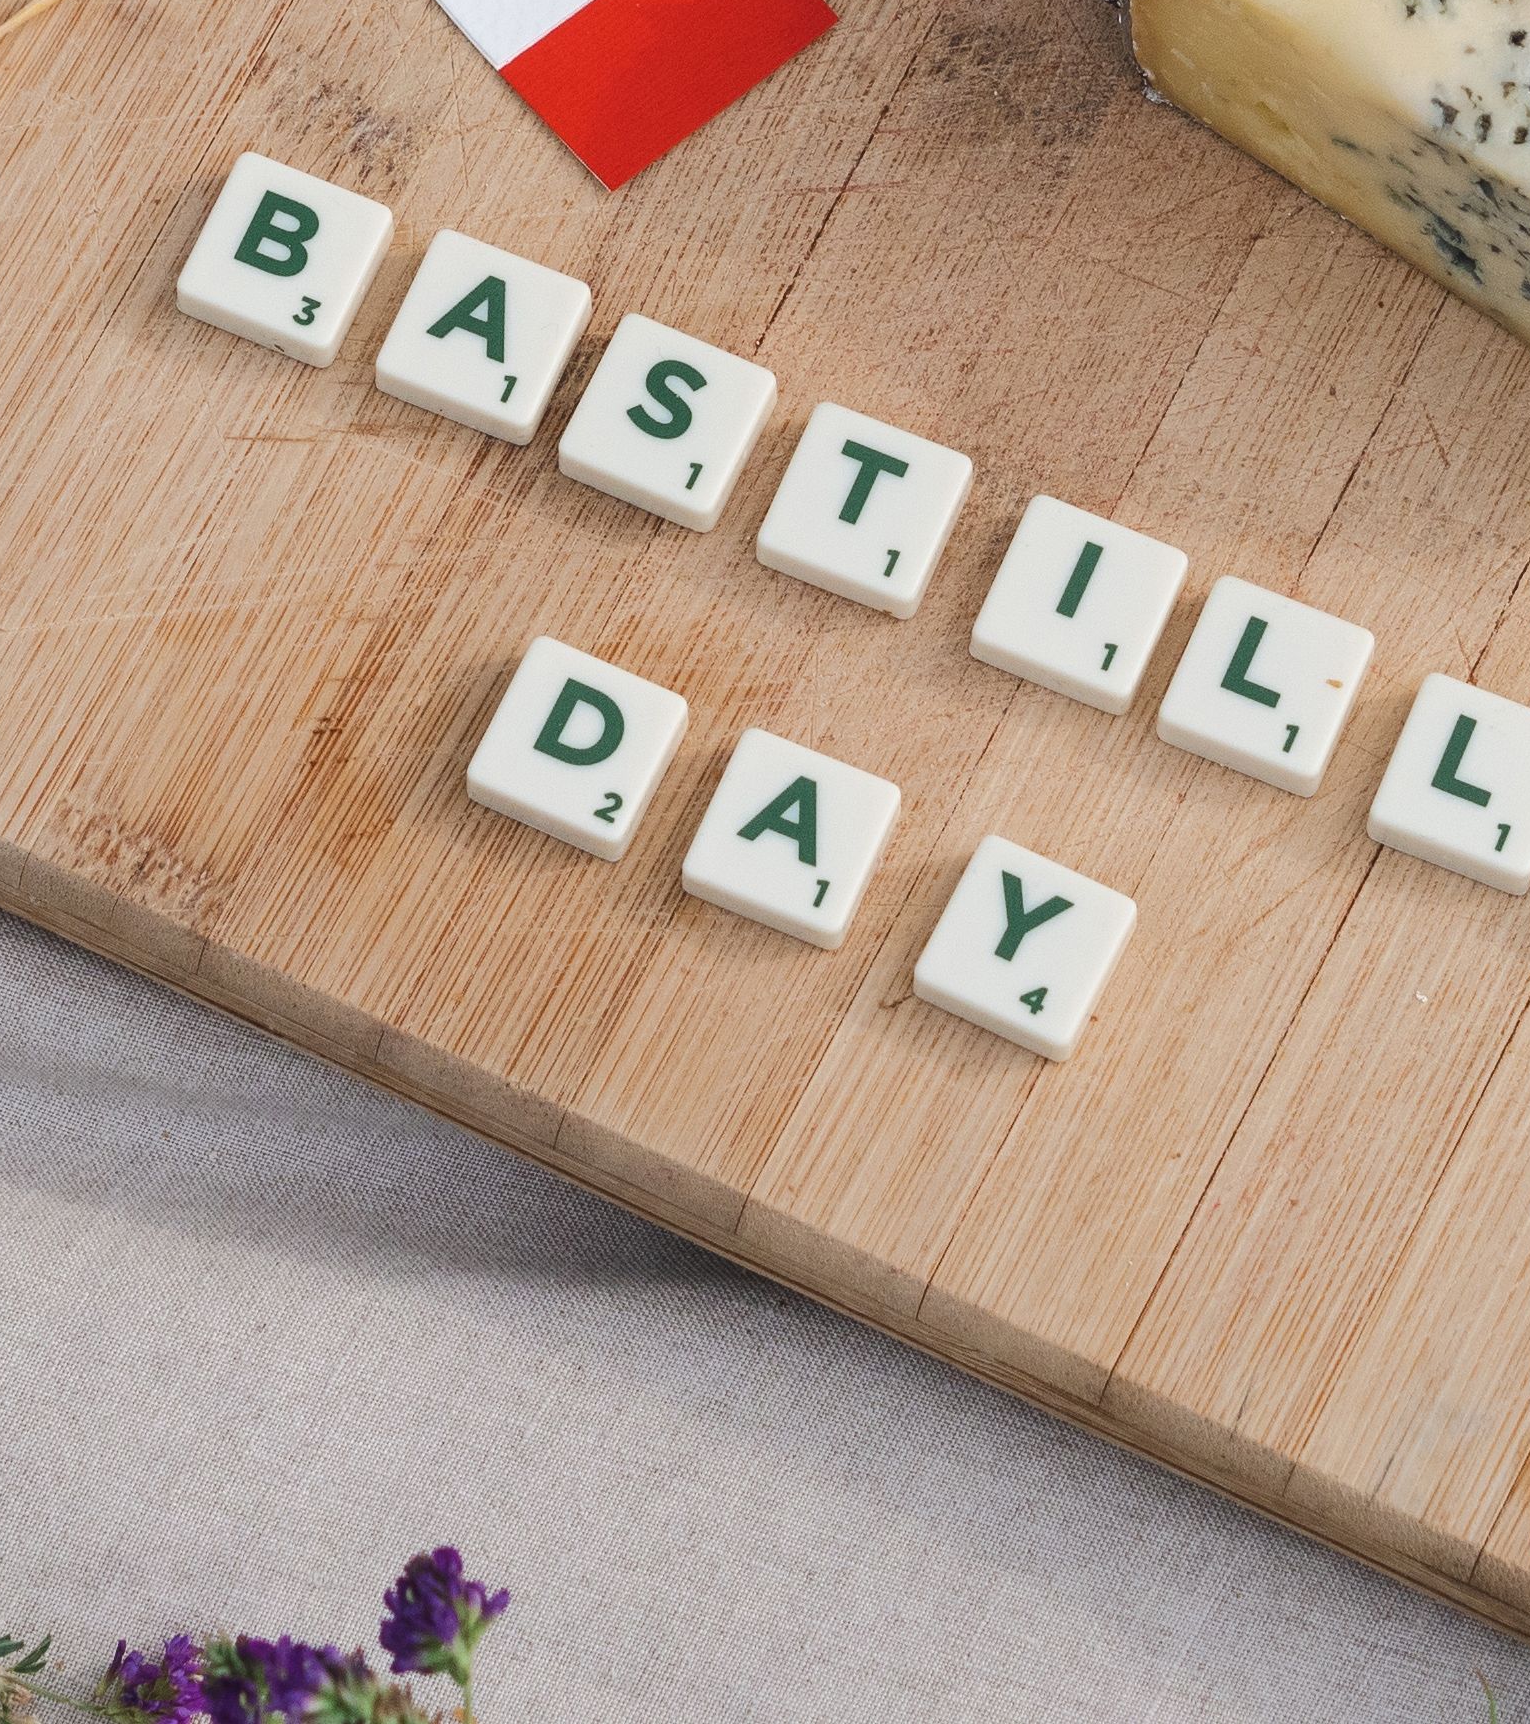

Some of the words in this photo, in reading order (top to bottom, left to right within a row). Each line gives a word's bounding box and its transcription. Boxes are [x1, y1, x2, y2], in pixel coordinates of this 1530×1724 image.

[292, 296, 322, 328] 3
[499, 374, 518, 404] 1
[685, 461, 705, 491] 1
[883, 548, 901, 577] 1
[1101, 642, 1119, 670] 1
[1282, 723, 1301, 753] 1
[532, 677, 1073, 963] DAY
[595, 791, 625, 825] 2
[1494, 822, 1511, 854] 1
[813, 878, 830, 908] 1
[1020, 986, 1047, 1016] 4
